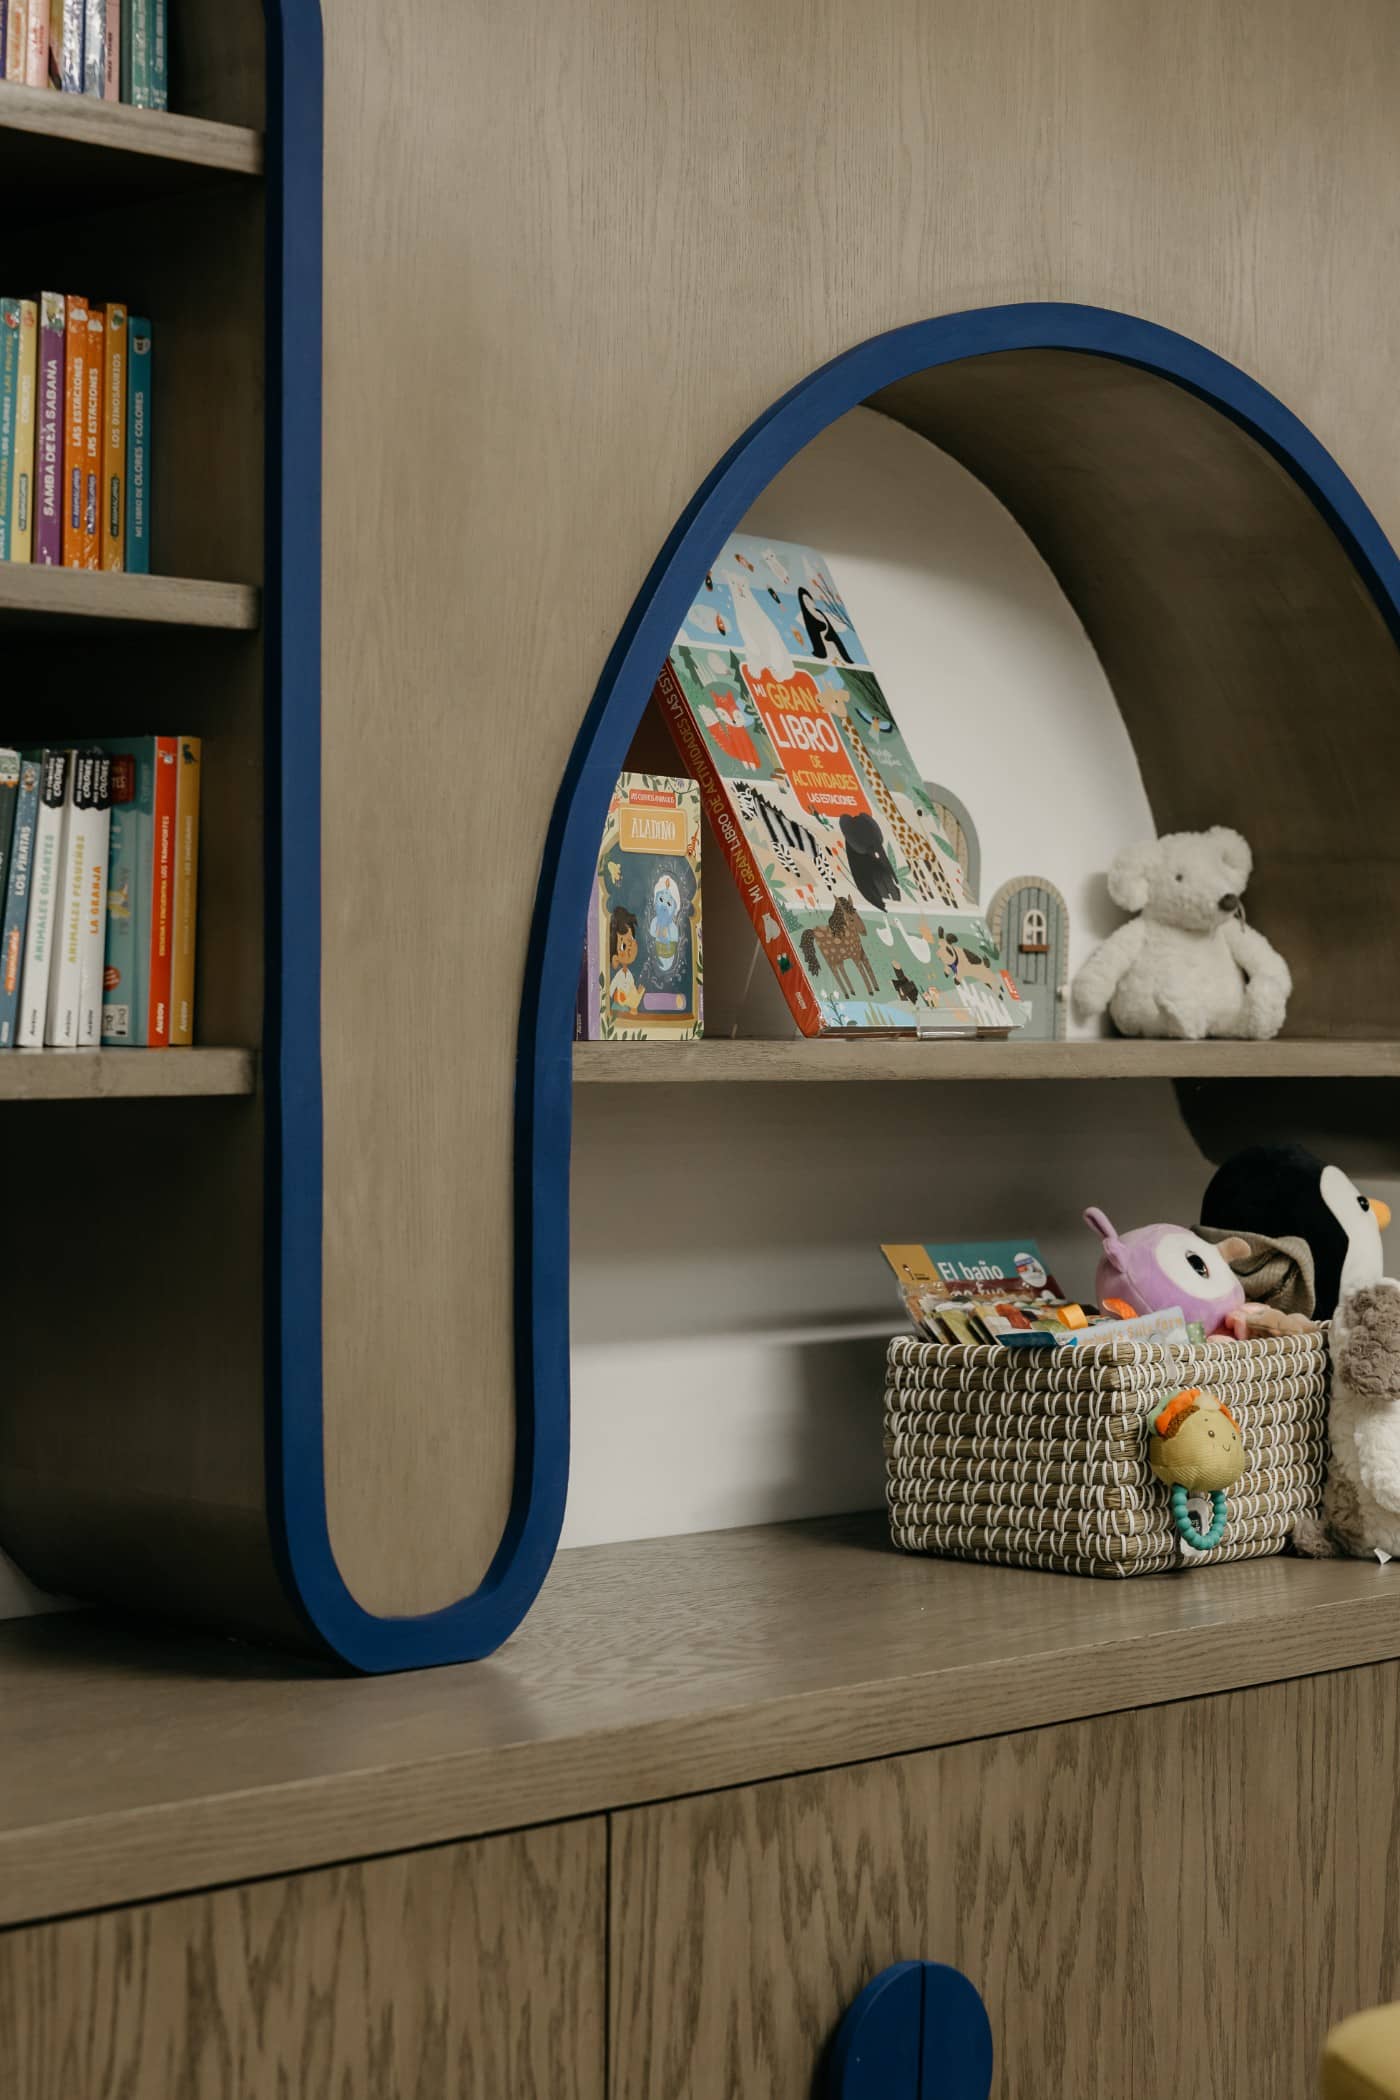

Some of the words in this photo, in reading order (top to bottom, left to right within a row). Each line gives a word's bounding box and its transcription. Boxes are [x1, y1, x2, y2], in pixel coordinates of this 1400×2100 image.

[45, 360, 57, 419] SABANA
[73, 358, 83, 422] ESTACIONES
[88, 368, 98, 432] ESTACIONES
[112, 354, 121, 425] DINOSAURIOS
[45, 422, 56, 442] LA
[135, 392, 144, 437] COLORES
[45, 444, 56, 462] DE
[73, 427, 82, 447] LAS
[88, 437, 97, 457] LAS
[112, 429, 120, 448] LOS
[134, 447, 143, 486] OLORES
[43, 465, 55, 516] SAMBA
[666, 694, 684, 720] LAS
[752, 683, 767, 698] MI
[766, 682, 818, 713] GRAN
[765, 712, 839, 753] LIBRO
[677, 719, 717, 794] ACTIVIDADES
[809, 754, 823, 769] DE
[53, 757, 65, 797] COLORES
[83, 759, 93, 798] COLORES
[99, 759, 110, 798] COLORES
[791, 769, 859, 790] ACTIVIDADES
[709, 796, 724, 813] DE
[160, 816, 169, 863] TRANSPORTES
[631, 817, 676, 840] ALADINO
[717, 813, 741, 851] LIBRO
[16, 825, 31, 871] PIRATAS
[40, 834, 55, 895] GIGANTES
[733, 849, 755, 884] GRAN
[15, 874, 26, 896] LOS
[90, 866, 101, 914] GRANJA
[160, 865, 168, 878] LOS
[748, 885, 763, 904] MI
[34, 900, 48, 962] ANIMALES
[68, 902, 80, 963] ANIMALES
[90, 920, 99, 934] LA
[937, 1262, 958, 1281] El
[958, 1260, 1005, 1281] baño
